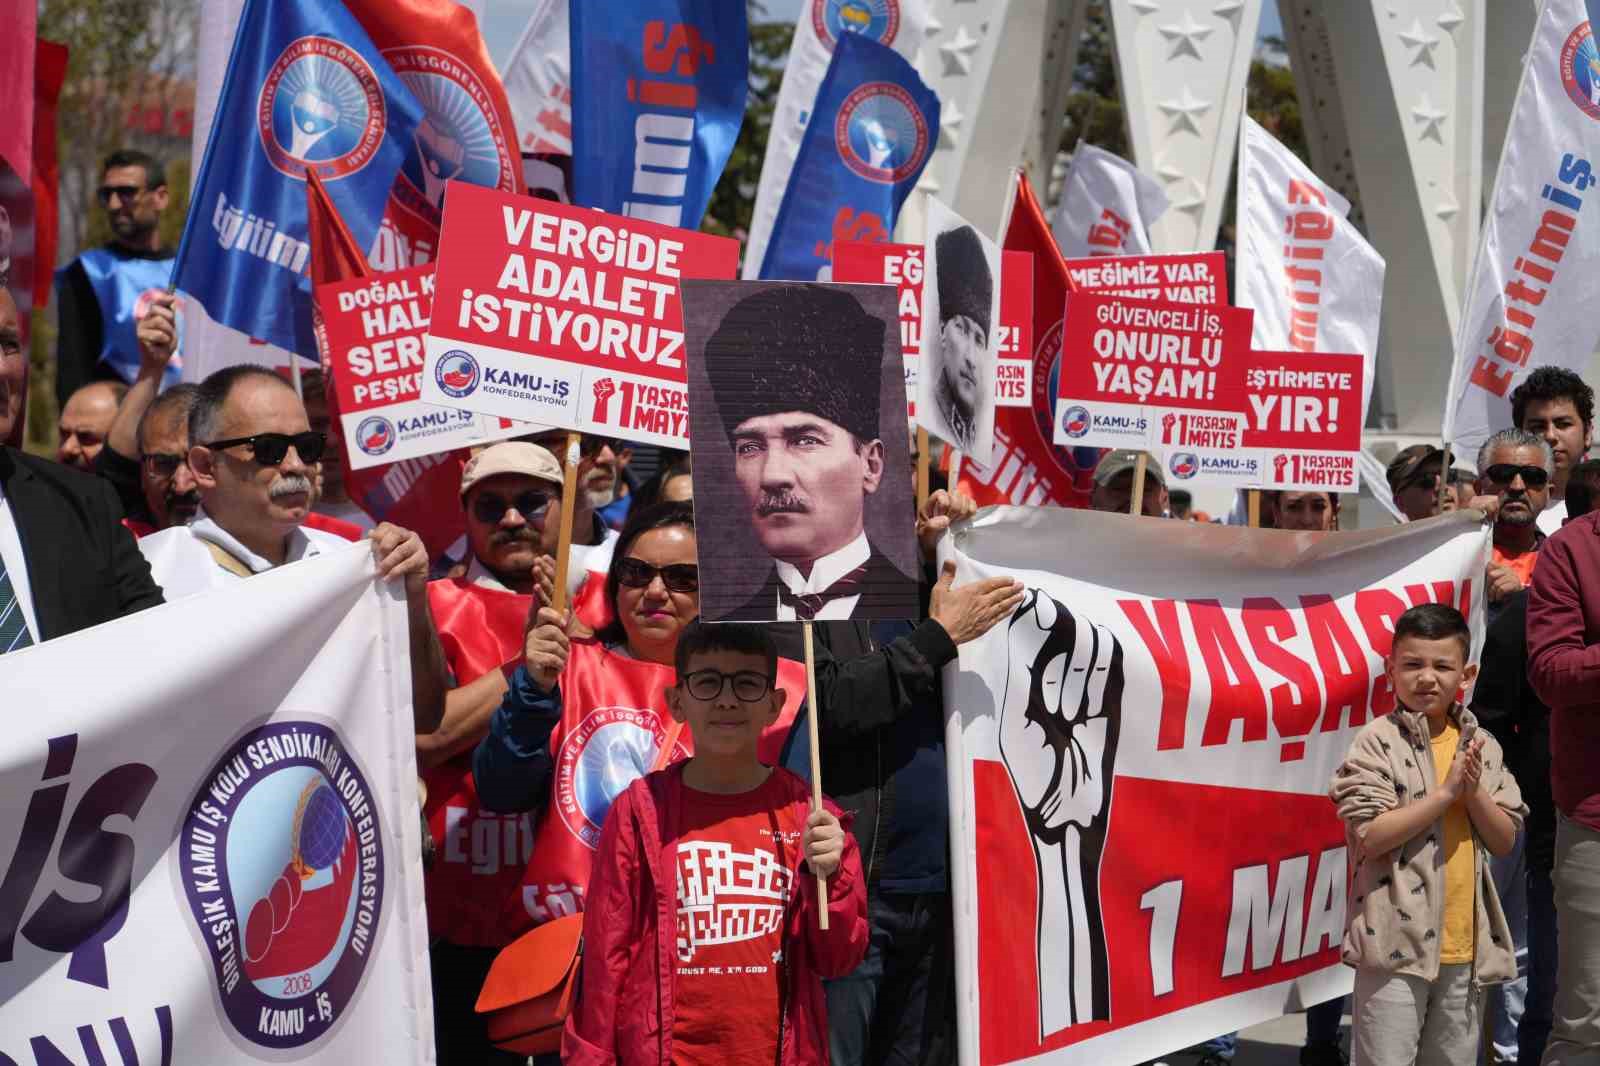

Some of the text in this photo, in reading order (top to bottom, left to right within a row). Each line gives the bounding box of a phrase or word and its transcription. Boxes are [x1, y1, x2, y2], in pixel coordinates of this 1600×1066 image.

[212, 191, 310, 274] Eğitim
[502, 205, 684, 278] VERGİDE
[884, 249, 924, 285] EĞ
[1070, 260, 1160, 287] MEĞİMİZ
[1284, 178, 1334, 353] Eğitim
[338, 280, 418, 312] DOĞAL
[497, 253, 675, 321] ADALET
[361, 298, 434, 339] HAL
[457, 288, 686, 369] İSTİYORUZ
[1096, 301, 1199, 331] GÜVENCELİ
[1093, 329, 1222, 368] ONURLU
[483, 385, 568, 407] KONFEDERASYONU
[1092, 361, 1216, 402] YAŞAM!
[633, 404, 690, 439] MAYI
[1247, 393, 1339, 434] YIR!
[1188, 430, 1237, 449] MAYIS
[1302, 469, 1353, 486] MAYIS
[1116, 578, 1472, 762] YAŞAS
[209, 756, 251, 806] KOLU
[191, 827, 221, 893] KAMU
[336, 766, 377, 956] KONFEDERASYONU
[1140, 846, 1351, 999] 1 MA
[202, 897, 240, 996] BİRLEŞİK
[283, 972, 313, 996] 2008
